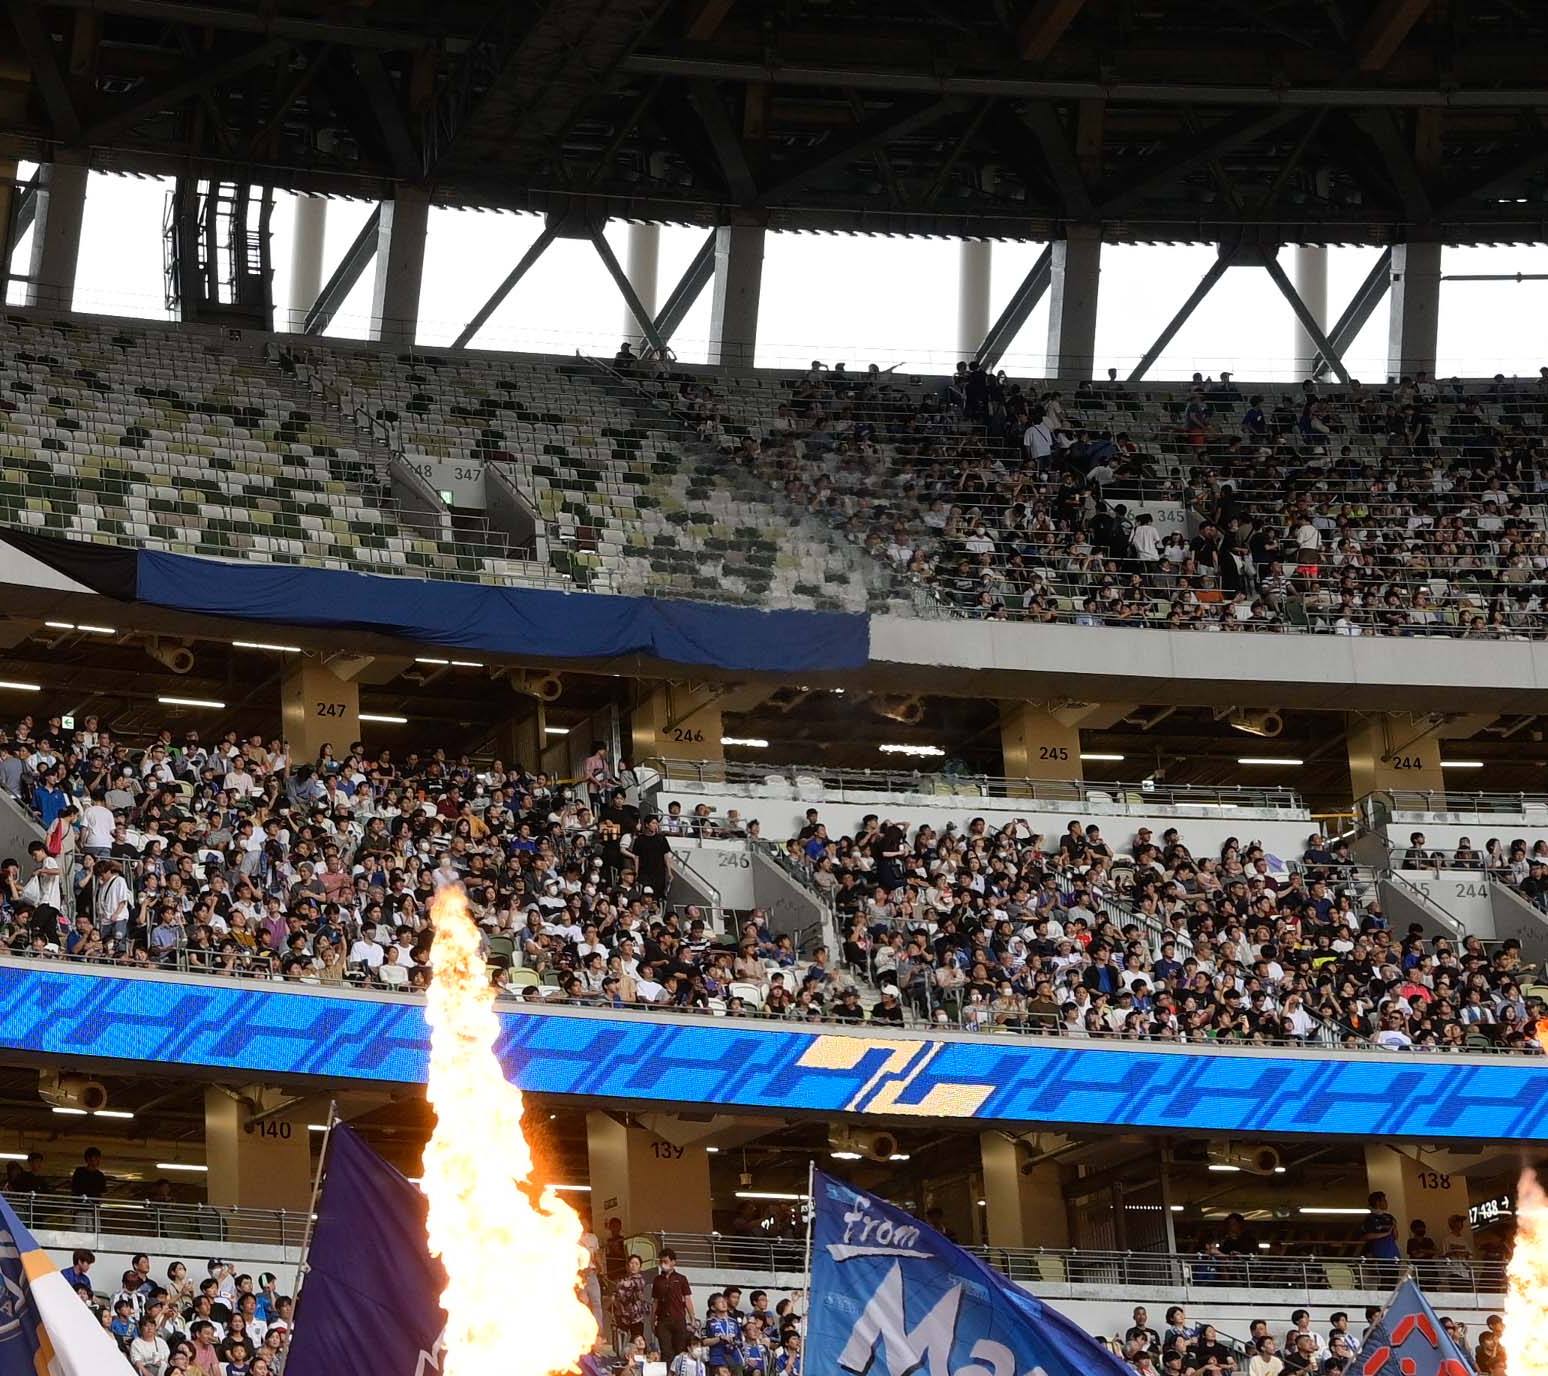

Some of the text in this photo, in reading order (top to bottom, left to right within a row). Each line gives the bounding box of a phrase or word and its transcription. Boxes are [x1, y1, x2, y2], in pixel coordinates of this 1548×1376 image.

[453, 466, 482, 482] 347
[1157, 510, 1186, 524] 345
[316, 702, 347, 718] 247
[674, 728, 704, 743] 246
[1039, 746, 1069, 761] 245
[1394, 756, 1423, 770] 244
[717, 854, 751, 869] 246
[1455, 883, 1489, 899] 244
[256, 1120, 292, 1140] 140
[1418, 1172, 1451, 1191] 138
[842, 1197, 920, 1248] from
